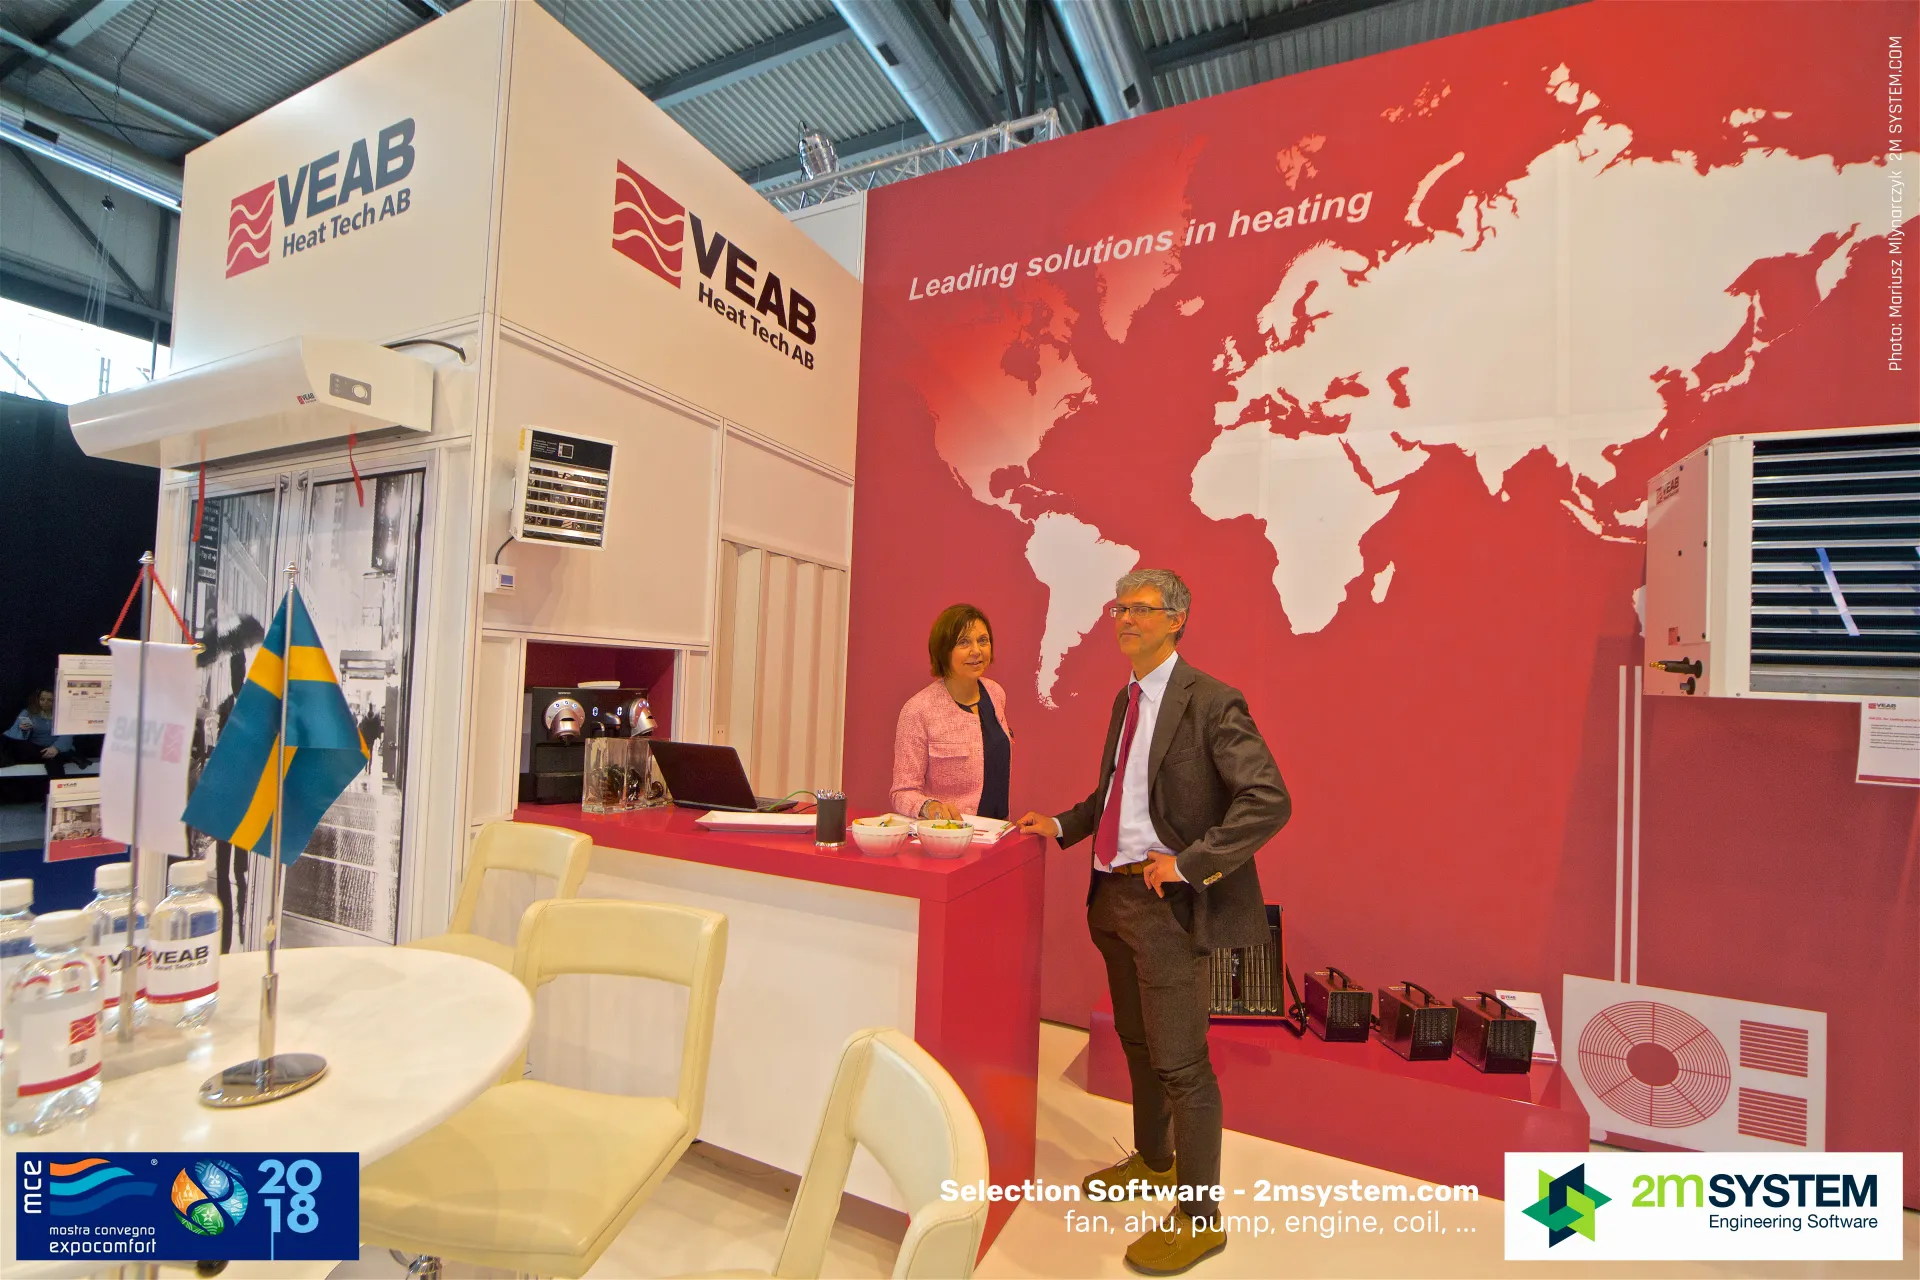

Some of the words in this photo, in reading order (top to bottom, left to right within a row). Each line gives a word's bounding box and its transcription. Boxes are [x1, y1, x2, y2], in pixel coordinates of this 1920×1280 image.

[277, 117, 416, 228] VEAB
[282, 221, 326, 258] Heat
[330, 202, 376, 239] Tech
[379, 187, 411, 222] AB
[688, 211, 817, 346] VEAB
[908, 260, 1019, 301] Leading
[1026, 227, 1174, 277] solutions
[1184, 219, 1216, 247] in
[1227, 190, 1374, 239] heating
[698, 281, 747, 330] Heat
[750, 314, 789, 356] Tech
[791, 344, 815, 371] AB
[152, 945, 209, 965] VEAB
